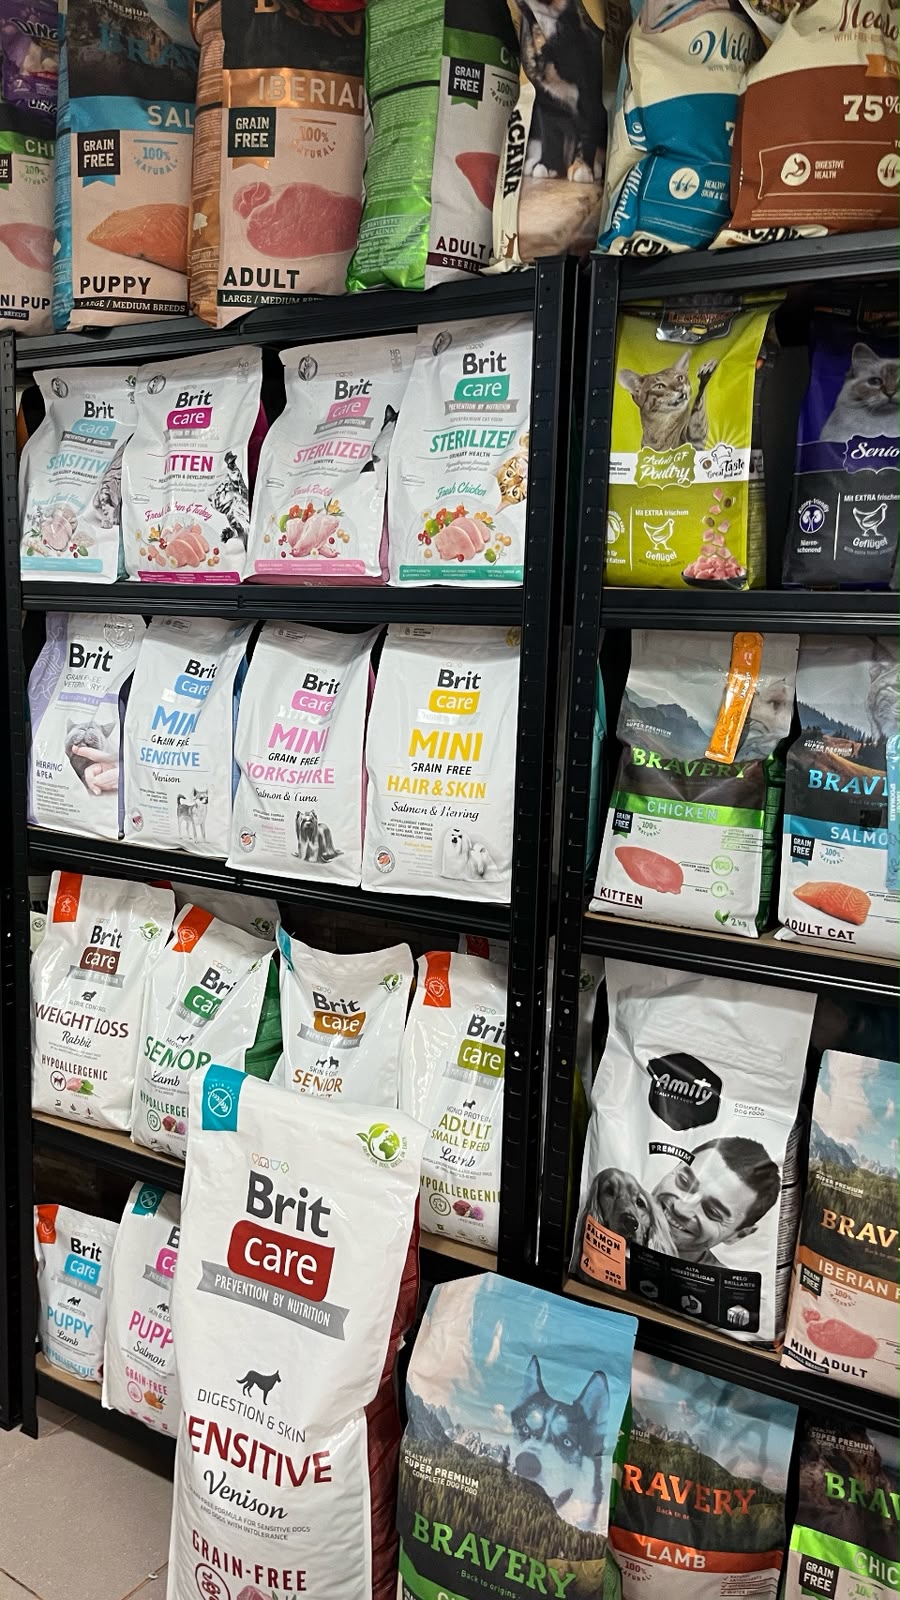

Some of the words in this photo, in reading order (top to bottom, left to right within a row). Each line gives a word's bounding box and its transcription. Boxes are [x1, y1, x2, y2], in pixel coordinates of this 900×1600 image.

[454, 65, 481, 79] GRAIN
[453, 77, 480, 94] FREE
[843, 94, 900, 122] 75%
[235, 116, 269, 130] GRAIN
[234, 132, 268, 149] FREE
[299, 125, 329, 143] 100%
[83, 138, 115, 152] GRAIN
[142, 146, 170, 160] 100%
[83, 152, 115, 169] FREE
[815, 160, 845, 170] DIGESTIVE
[814, 171, 837, 179] HEALTH
[435, 235, 486, 259] ADULT
[79, 275, 152, 296] PUPPY
[222, 266, 300, 290] ADULT
[80, 298, 105, 308] LARGE
[112, 301, 151, 311] MEDIUM
[152, 304, 185, 313] BREEDS
[222, 294, 252, 303] LARGE
[261, 295, 300, 305] MEDIUM
[462, 350, 507, 376] Brit
[175, 389, 214, 409] Brit
[334, 378, 372, 401] Brit
[462, 382, 502, 397] care
[83, 400, 114, 419] Brit
[171, 411, 206, 425] care
[332, 401, 361, 418] care
[78, 422, 110, 436] care
[293, 441, 371, 464] STERILIZED
[449, 451, 468, 460] URINARY
[469, 451, 491, 460] HEALTH
[672, 452, 690, 464] GF
[850, 442, 900, 460] Senio
[640, 466, 691, 484] Poultry
[724, 458, 745, 472] Taste
[457, 482, 487, 497] Chicken
[855, 493, 876, 502] EXTRA
[645, 509, 664, 517] EXTRA
[664, 509, 689, 517] frischem
[853, 537, 888, 550] Geflügel
[645, 550, 677, 562] Geflügel
[68, 642, 113, 672] Brit
[181, 680, 210, 696] care
[302, 672, 341, 695] Brit
[437, 668, 482, 690] Brit
[299, 696, 333, 712] care
[436, 694, 473, 710] care
[408, 727, 484, 762] MINI
[36, 759, 63, 772] HERRING
[140, 746, 201, 767] SENSITIVE
[268, 752, 297, 764] GRAIN
[300, 756, 320, 766] FREE
[631, 746, 746, 779] BRAVERY
[41, 770, 53, 780] PEA
[152, 771, 182, 784] Venison
[246, 761, 335, 785] YORKSHIRE
[411, 762, 442, 774] GRAIN
[446, 765, 473, 776] FREE
[283, 791, 291, 802] &
[387, 774, 430, 796] HAIR
[431, 779, 443, 797] &
[445, 780, 487, 799] SKIN
[391, 801, 428, 816] Salmon
[429, 805, 438, 816] &
[440, 804, 480, 823] Herring
[616, 811, 631, 821] GRAIN
[646, 800, 719, 821] CHICKEN
[614, 819, 630, 829] FREE
[793, 837, 812, 847] GRAIN
[830, 826, 889, 846] SALMO
[792, 845, 810, 857] FREE
[824, 847, 841, 857] 100%
[600, 886, 643, 906] KITTEN
[90, 925, 123, 949] Brit
[784, 917, 823, 936] ADULT
[827, 929, 855, 941] CAT
[84, 950, 117, 970] care
[312, 990, 361, 1014] Brit
[35, 1002, 95, 1032] WEIGHT
[94, 1017, 129, 1039] LOSS
[322, 1014, 360, 1033] care
[62, 1030, 92, 1049] Rabbit
[41, 1053, 109, 1081] HYPOALLERGENIC
[462, 1045, 502, 1070] care
[151, 1070, 182, 1087] Lamb
[292, 1068, 343, 1093] SENIOR
[655, 1073, 713, 1106] Amity
[734, 1107, 747, 1115] DOG
[438, 1113, 492, 1140] ADULT
[431, 1128, 460, 1147] SMALL
[461, 1138, 491, 1152] BREED
[651, 1143, 693, 1162] PREMIUM
[816, 1173, 834, 1184] SUPER
[834, 1180, 864, 1195] PREMIUM
[245, 1169, 332, 1239] Brit
[587, 1223, 620, 1251] SALMON
[592, 1238, 612, 1255] RICE
[70, 1236, 102, 1263] Brit
[69, 1259, 96, 1280] care
[244, 1236, 318, 1286] care
[685, 1265, 700, 1273] ALTA
[605, 1269, 621, 1280] GMO
[723, 1279, 756, 1289] BRILLANTE
[802, 1274, 820, 1292] FREE
[803, 1267, 821, 1282] GRAIN
[818, 1259, 889, 1297] IBERIAN
[213, 1273, 269, 1303] PREVENTION
[272, 1291, 285, 1309] BY
[287, 1297, 331, 1328] NUTRITION
[47, 1306, 94, 1339] PUPPY
[57, 1329, 79, 1347] Lamb
[133, 1340, 166, 1368] Salmon
[789, 1337, 818, 1362] MINI
[820, 1356, 868, 1379] ADULT
[125, 1365, 168, 1396] GRAIN-FREE
[197, 1387, 266, 1426] DIGESTION
[266, 1414, 275, 1430] &
[277, 1420, 307, 1444] SKIN
[184, 1411, 333, 1489] ENSITIVE
[811, 1431, 836, 1444] SUPER
[838, 1437, 875, 1451] PREMIUM
[404, 1448, 433, 1464] HEALTHY
[404, 1455, 432, 1476] SUPER
[434, 1466, 479, 1489] PREMIUM
[412, 1469, 445, 1487] COMPLETE
[445, 1478, 460, 1491] DOG
[460, 1483, 478, 1497] FOOD
[623, 1463, 756, 1516] RAVERY
[202, 1469, 289, 1520] Venison
[214, 1503, 243, 1523] FORMULA
[243, 1517, 256, 1528] FOR
[257, 1521, 291, 1534] SENSITIVE
[291, 1525, 311, 1534] DOGS
[655, 1504, 673, 1517] Back
[211, 1508, 227, 1524] DOGS
[226, 1518, 243, 1531] WITH
[243, 1524, 289, 1541] INTOLERANCE
[191, 1528, 308, 1592] GRAIN-FREE
[411, 1510, 577, 1600] BRAVERY
[646, 1542, 707, 1570] LAMB
[624, 1559, 648, 1575] 100%
[805, 1560, 834, 1580] GRAIN
[460, 1568, 479, 1585] Back
[479, 1578, 488, 1588] to
[489, 1581, 518, 1600] origins
[802, 1571, 832, 1593] FREE
